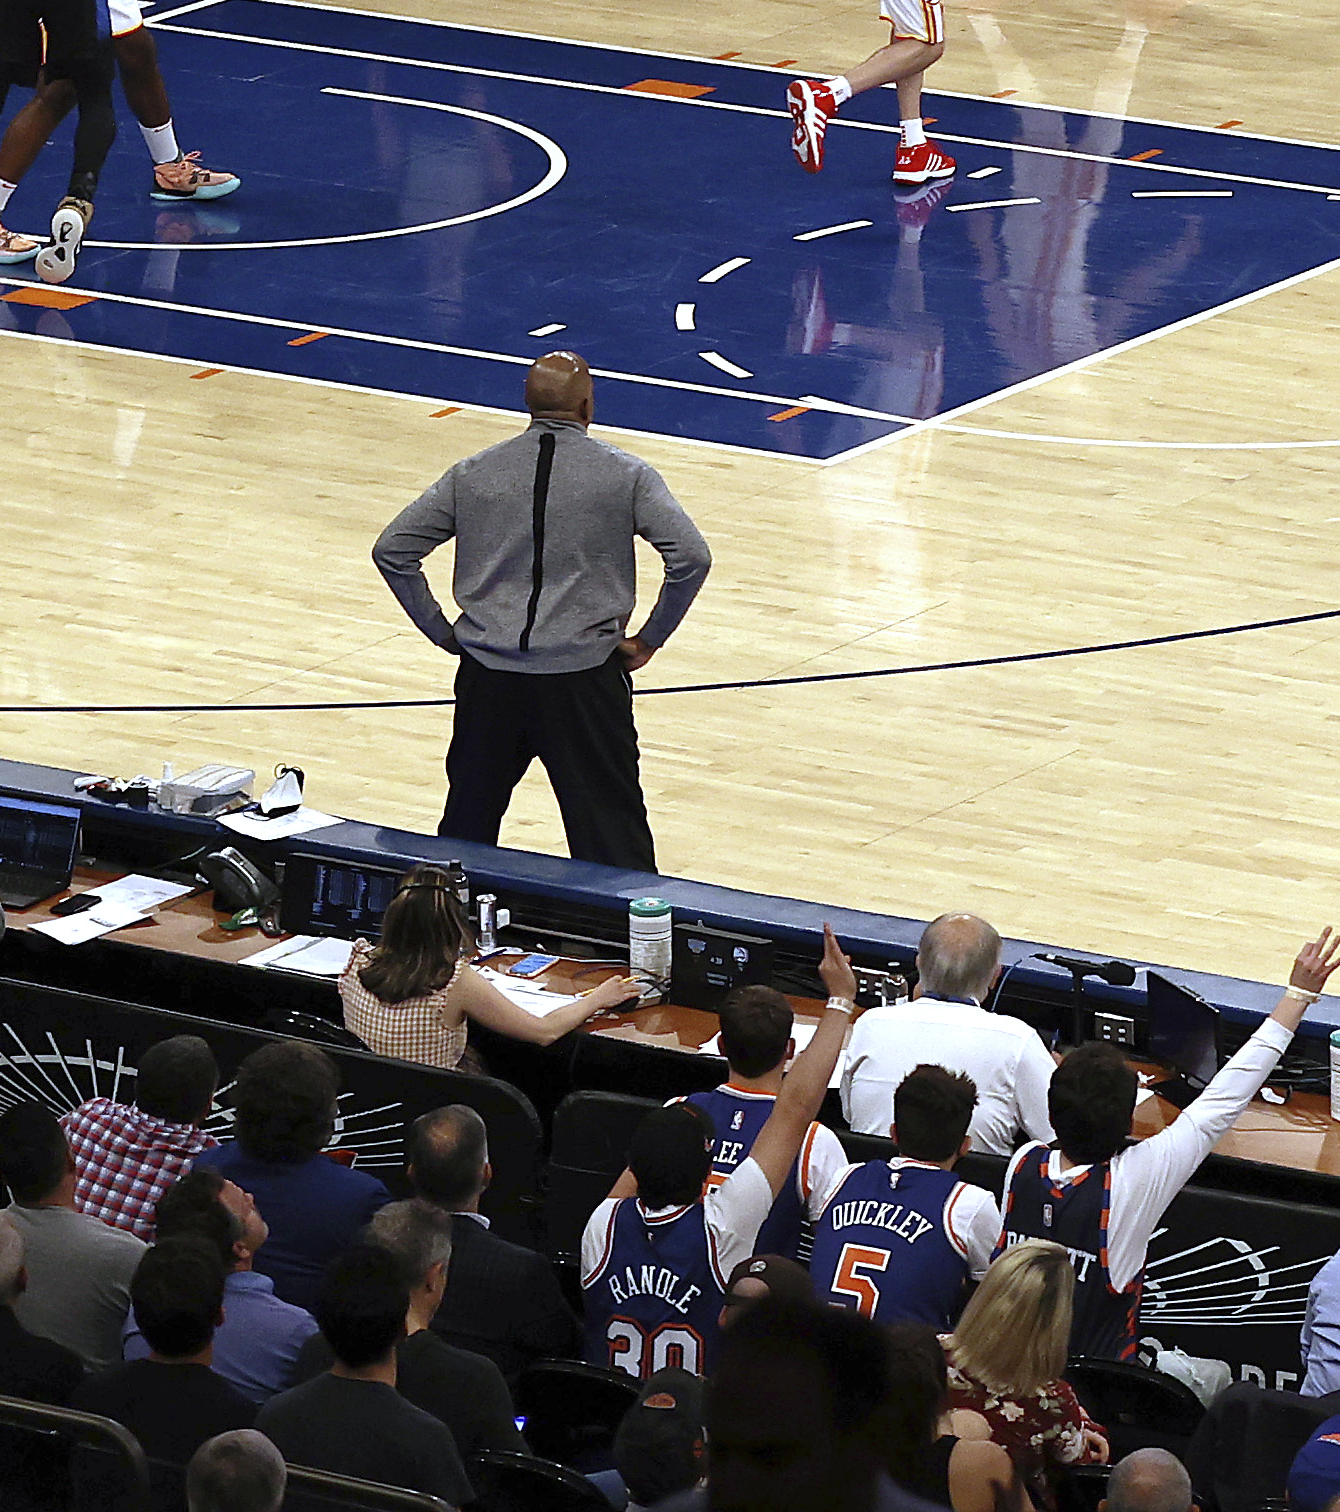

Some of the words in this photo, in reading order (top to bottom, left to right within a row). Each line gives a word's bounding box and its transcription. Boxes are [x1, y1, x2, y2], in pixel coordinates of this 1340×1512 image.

[713, 1140, 745, 1166] EE
[832, 1199, 934, 1244] QUICKLEY
[609, 1263, 702, 1316] RANDLE
[830, 1242, 893, 1320] 5
[606, 1315, 706, 1379] 30
